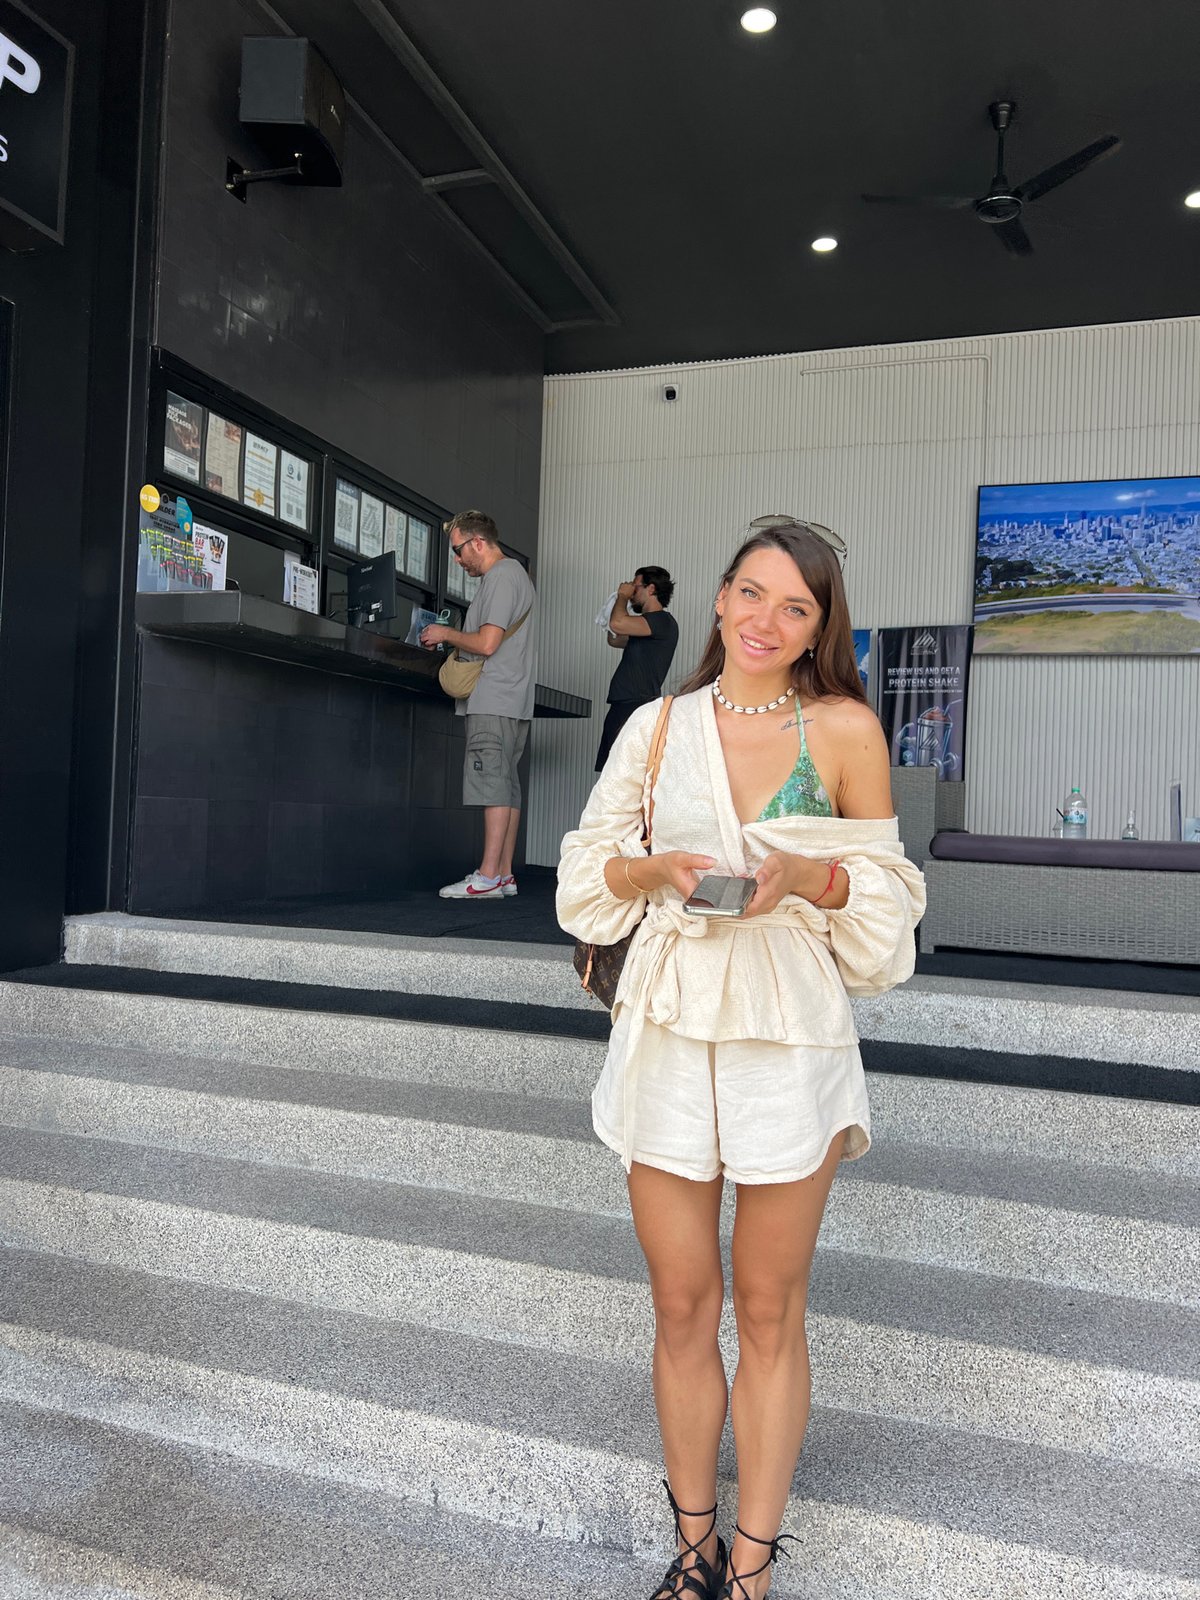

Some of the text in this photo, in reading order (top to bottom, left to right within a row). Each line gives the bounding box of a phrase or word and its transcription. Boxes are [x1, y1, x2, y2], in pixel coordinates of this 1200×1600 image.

[888, 667, 960, 676] REVIEW US AND GET A
[889, 678, 959, 687] PROTEIN SHAKE
